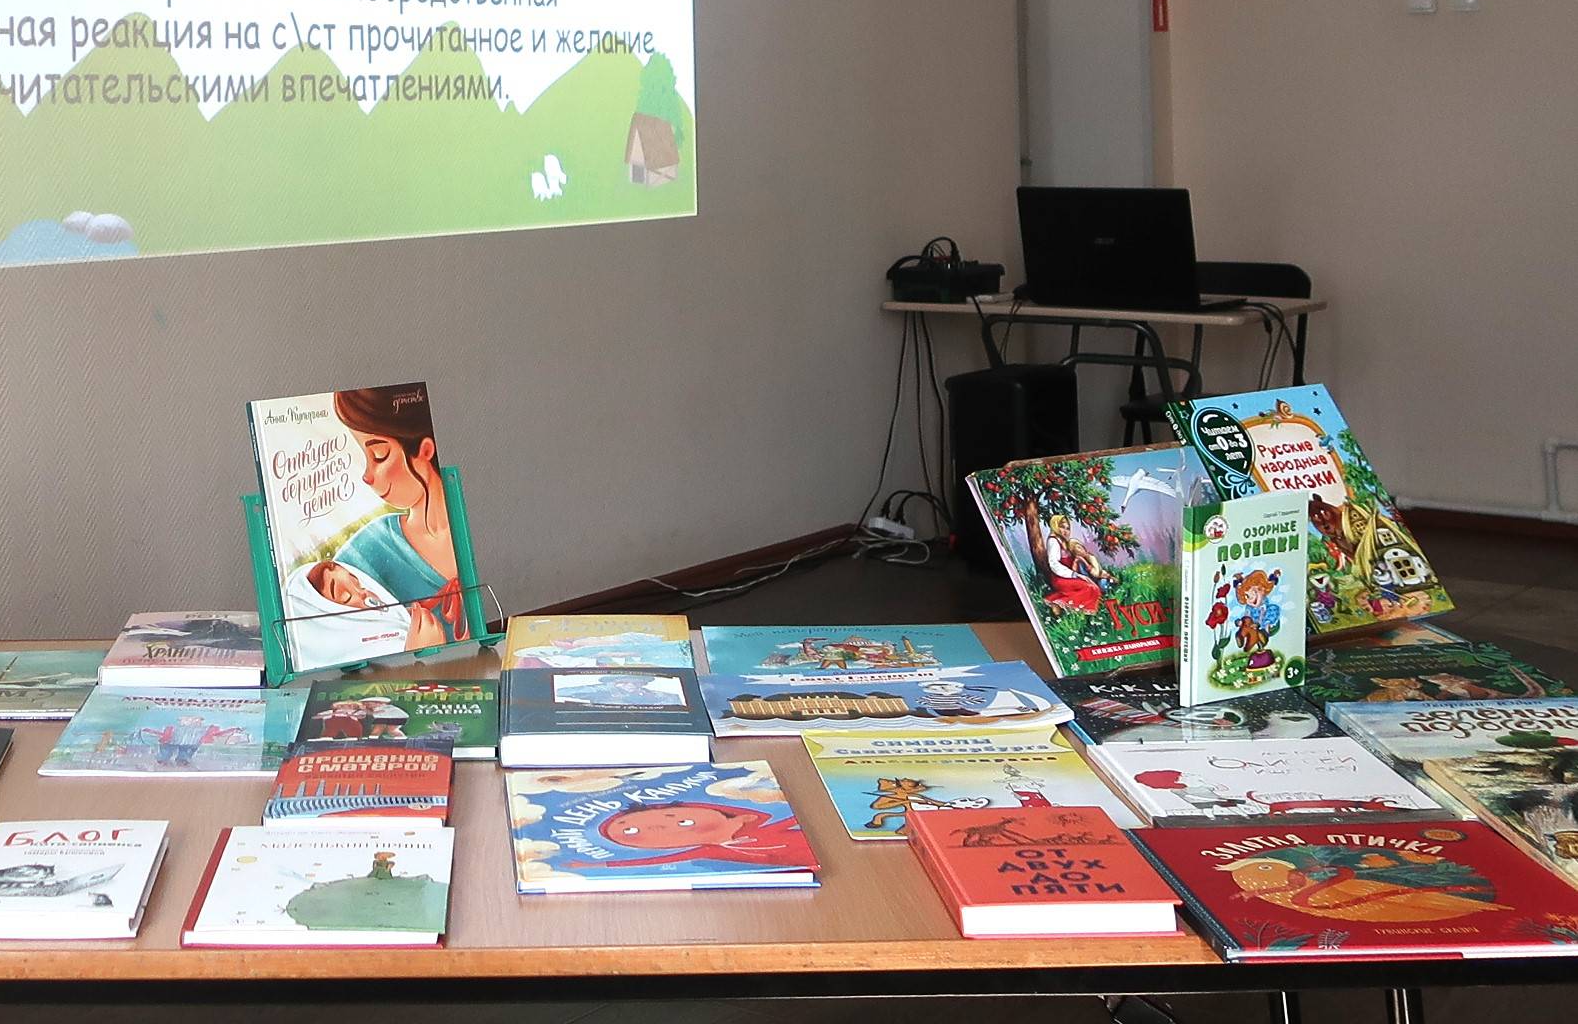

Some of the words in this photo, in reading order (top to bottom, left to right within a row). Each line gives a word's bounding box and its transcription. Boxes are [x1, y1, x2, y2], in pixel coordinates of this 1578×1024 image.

[71, 17, 212, 61] реакция
[223, 21, 263, 49] на
[347, 24, 523, 61] прочитанное
[531, 28, 547, 52] и
[555, 29, 655, 54] желание
[281, 74, 510, 101] впечатлениями.
[1200, 424, 1240, 437] Читаем
[1236, 432, 1248, 448] 3
[272, 433, 348, 480] Откуда
[1256, 440, 1314, 459] Русские
[1260, 454, 1329, 474] народные
[281, 453, 352, 503] берутся
[297, 473, 356, 527] дети?
[1243, 520, 1297, 539] ОЗОРНЫЕ
[1217, 534, 1300, 563] ПОТЕШКИ
[1286, 666, 1300, 679] 3+
[833, 744, 1050, 756] Санкт-Петербурга
[870, 738, 993, 747] СИМВОЛЫ
[552, 799, 623, 826] ДЕНЬ
[2, 828, 135, 847] БЛОГ
[1199, 833, 1307, 860] ЗОЛОТАЯ
[1326, 832, 1445, 856] ПТИЧКА
[1014, 848, 1068, 859] ОТ
[997, 859, 1109, 873] ДВУХ
[1029, 871, 1092, 884] ДО
[1010, 882, 1126, 896] ПЯТИ
